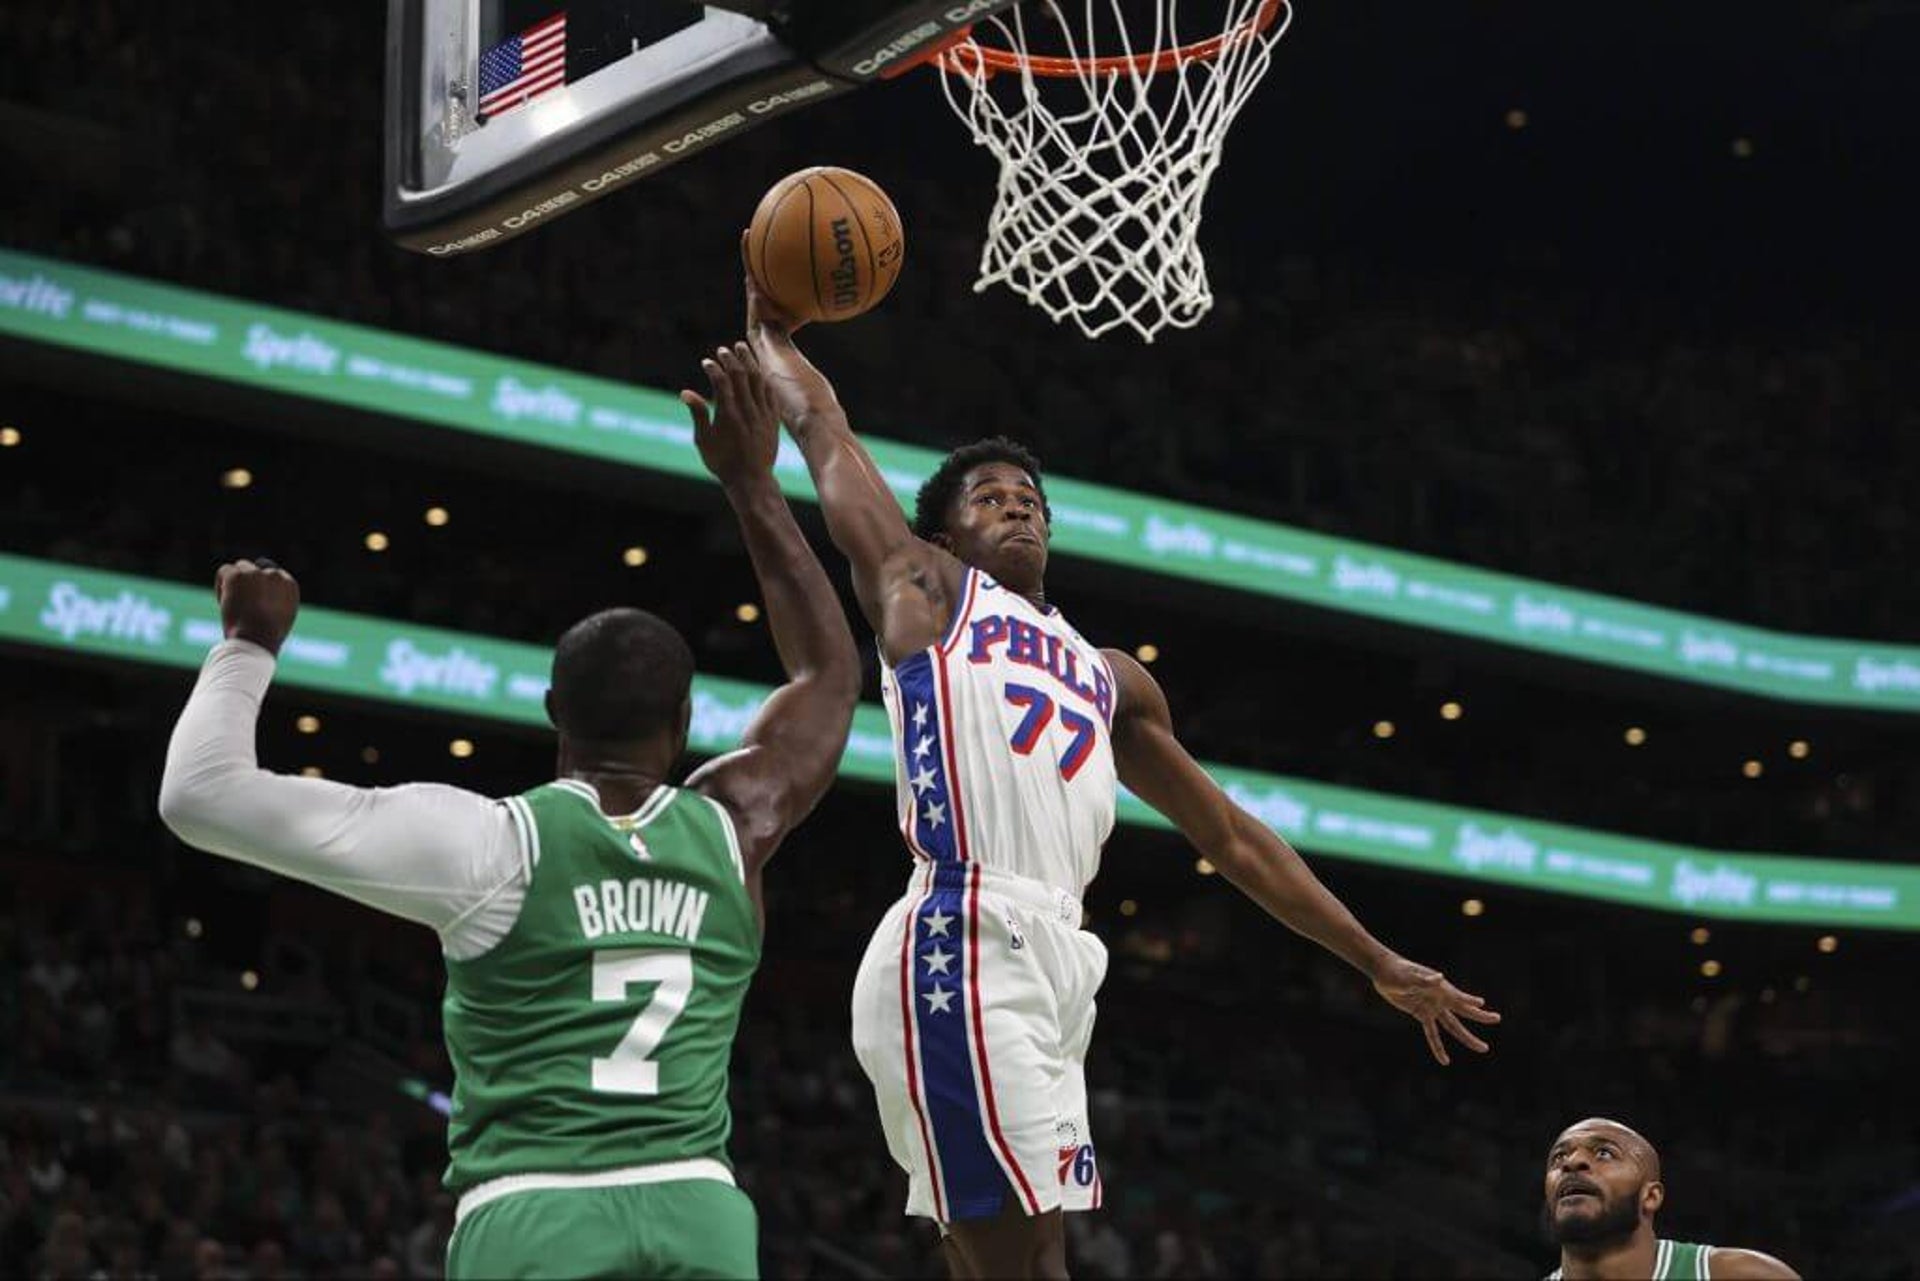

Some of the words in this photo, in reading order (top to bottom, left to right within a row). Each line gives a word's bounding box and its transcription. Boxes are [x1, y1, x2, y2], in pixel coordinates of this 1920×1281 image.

[852, 47, 897, 75] C4
[662, 132, 704, 153] C4
[581, 171, 621, 192] C4
[831, 217, 857, 305] Wilson
[41, 582, 170, 642] Sprite
[380, 638, 497, 697] Sprite
[1004, 682, 1096, 782] 77
[573, 878, 709, 943] BROWN
[591, 949, 693, 1095] 7
[1057, 1144, 1095, 1187] 76
